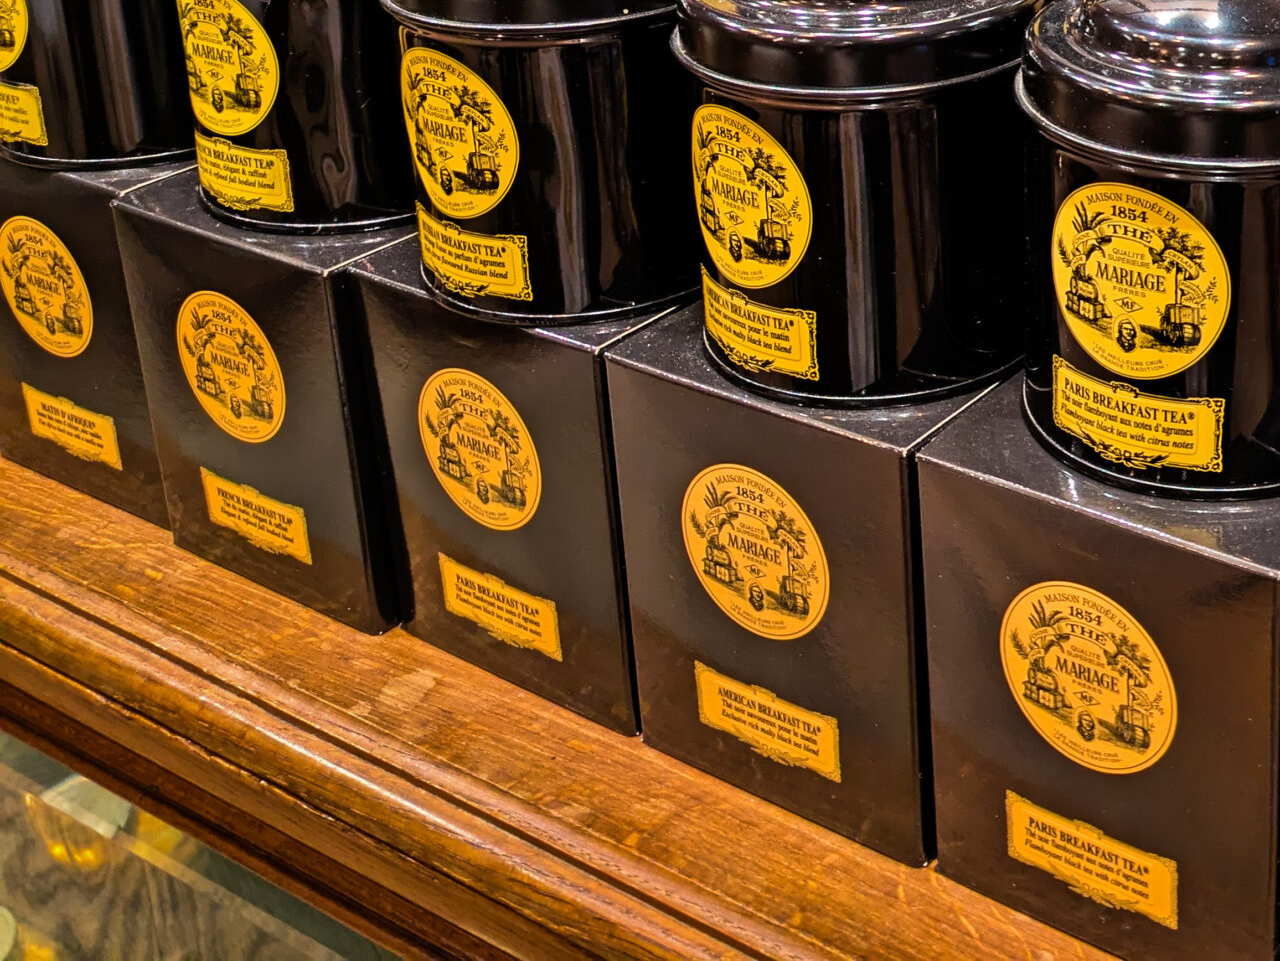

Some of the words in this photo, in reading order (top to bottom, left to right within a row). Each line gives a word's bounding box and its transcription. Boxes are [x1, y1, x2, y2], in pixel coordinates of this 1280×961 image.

[191, 41, 235, 65] MARIAGE
[422, 67, 447, 82] 1854
[421, 115, 468, 144] MARIAGE
[715, 125, 741, 143] 1854
[213, 150, 251, 167] BREAKFAST
[711, 177, 760, 209] MARIAGE
[1086, 192, 1123, 205] MAISON
[1125, 194, 1163, 216] FONDÉE
[1165, 211, 1180, 225] EN
[1110, 204, 1149, 223] 1854
[440, 232, 481, 255] BREAKFAST
[1107, 224, 1153, 244] THÉ
[25, 272, 61, 296] MARIAGE
[1095, 261, 1166, 294] MARIAGE
[730, 299, 771, 327] BREAKFAST
[210, 350, 251, 378] MARIAGE
[41, 402, 61, 417] MATIN
[1064, 377, 1090, 400] PARIS
[1092, 391, 1160, 420] BREAKFAST
[1060, 402, 1094, 429] Flamboyant
[1096, 419, 1115, 436] black
[1116, 428, 1127, 438] tea
[1129, 431, 1145, 443] with
[1147, 435, 1170, 447] citrus
[1172, 440, 1194, 449] notes
[1072, 397, 1083, 408] noir
[1084, 402, 1118, 424] flamboyant
[1120, 417, 1132, 426] aux
[1134, 420, 1152, 432] notes
[456, 431, 502, 462] MARIAGE
[217, 486, 242, 508] FRENCH
[241, 497, 277, 523] BREAKFAST
[727, 532, 783, 566] MARIAGE
[456, 574, 476, 591] PARIS
[477, 583, 519, 610] BREAKFAST
[1068, 605, 1103, 626] 1854
[1055, 655, 1121, 694] MARIAGE
[718, 686, 757, 711] AMERICAN
[758, 703, 801, 730] BREAKFAST
[1029, 817, 1058, 839] PARIS
[1060, 831, 1121, 866] BREAKFAST
